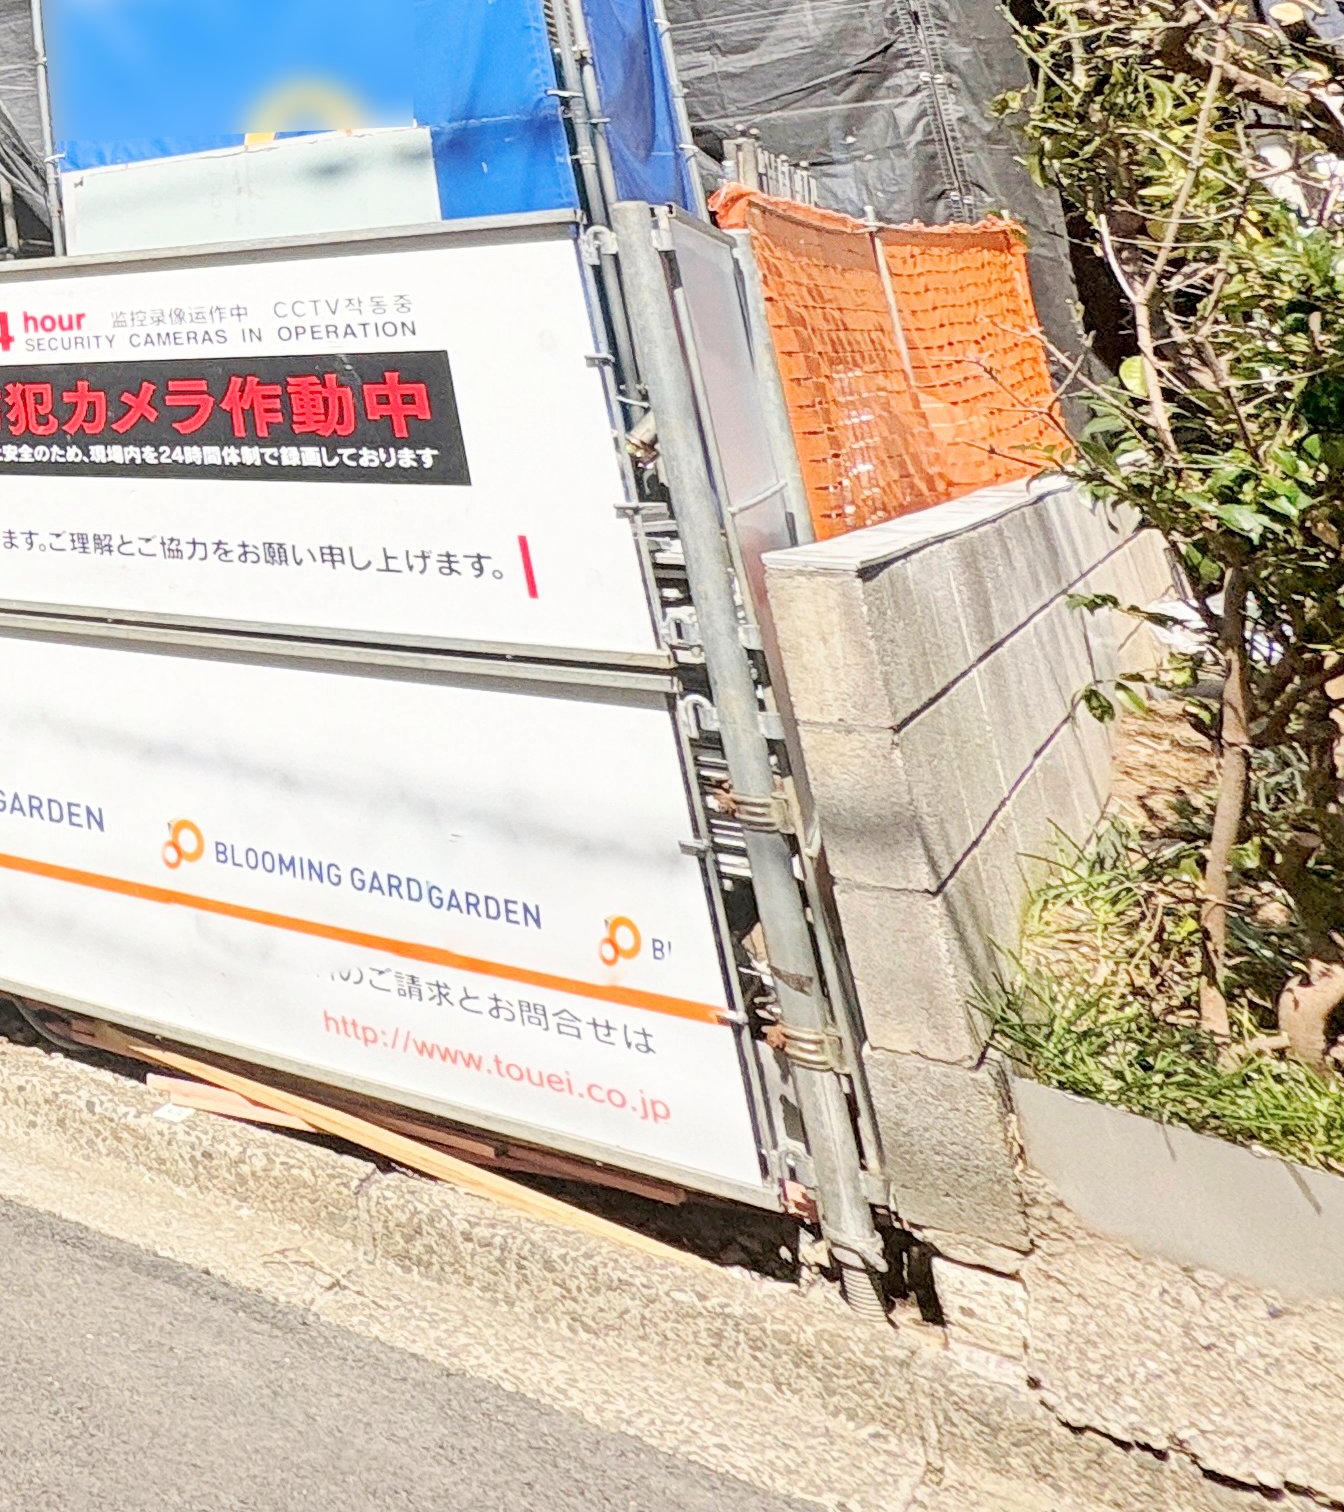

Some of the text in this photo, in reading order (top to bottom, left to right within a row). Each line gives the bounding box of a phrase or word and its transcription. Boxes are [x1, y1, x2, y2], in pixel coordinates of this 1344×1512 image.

[22, 310, 86, 333] hour
[111, 304, 249, 329] 监控录像运作中
[273, 294, 413, 319] CCTV작동중
[25, 320, 417, 352] SECURITY CAMERAS IN OPERATION
[214, 840, 342, 887] BLOOMING
[330, 967, 657, 1055] のご請求とお問合せは
[323, 1009, 672, 1124] http://www.touei.co.jp
